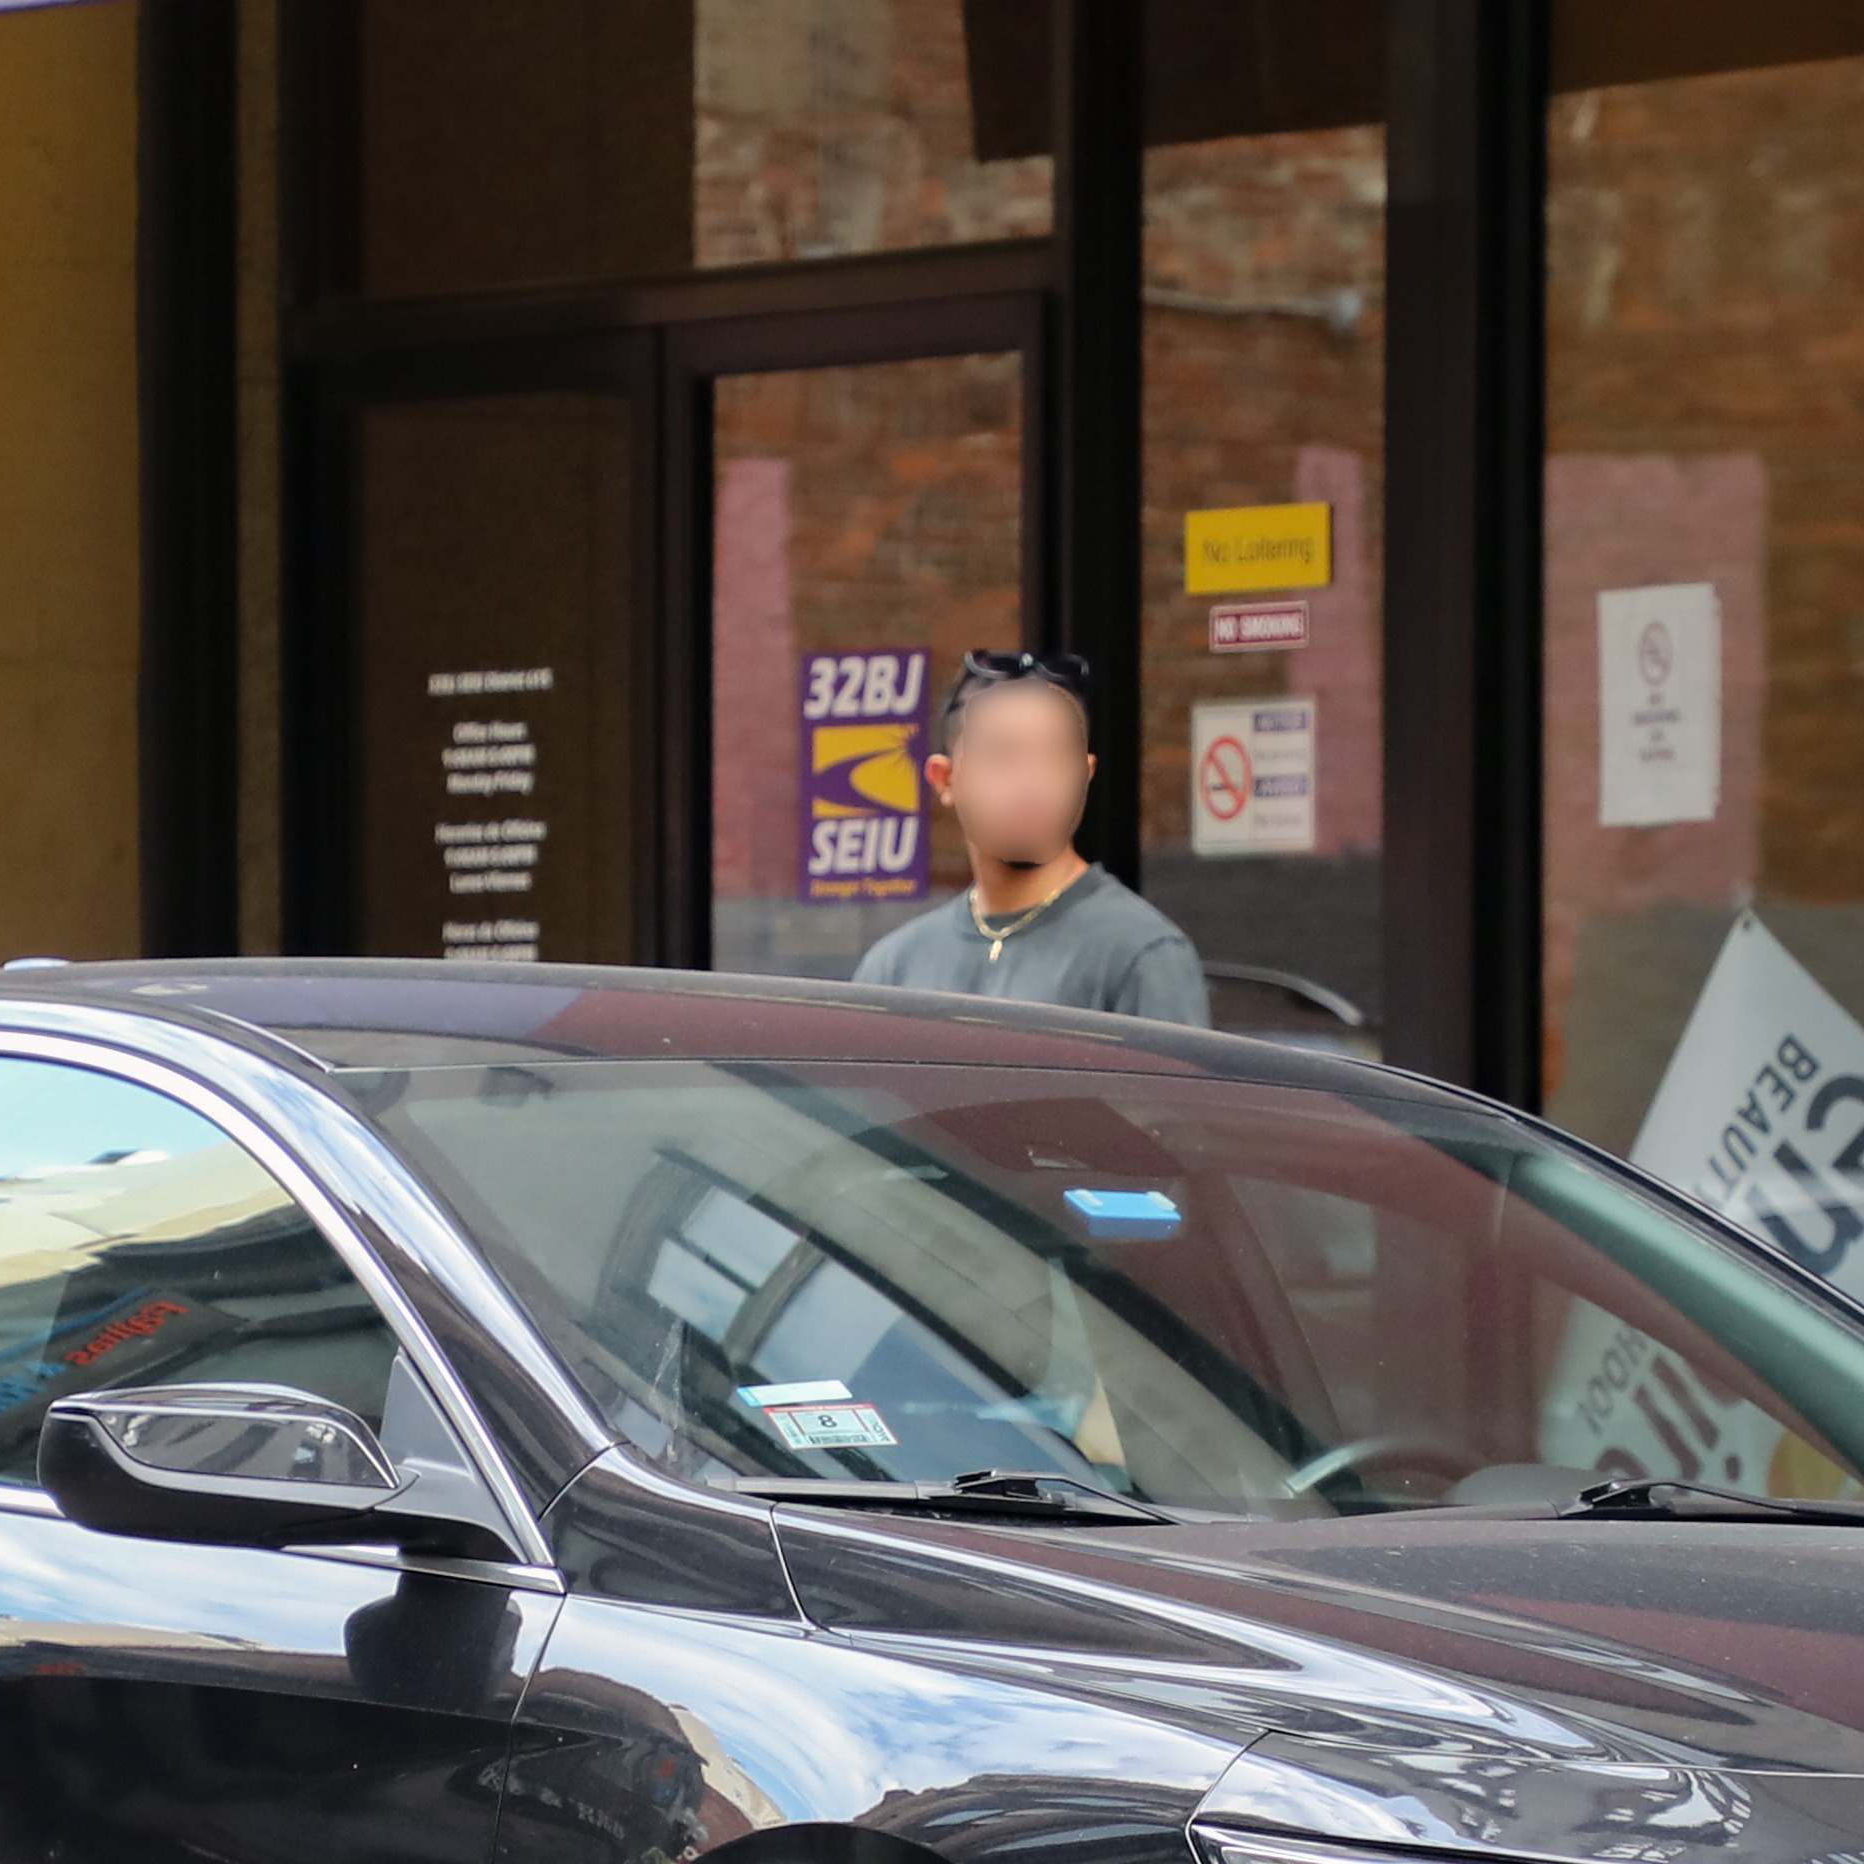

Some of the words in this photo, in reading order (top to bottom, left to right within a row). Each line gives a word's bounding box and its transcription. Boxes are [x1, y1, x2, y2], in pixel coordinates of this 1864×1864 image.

[803, 653, 925, 719] 32BJ
[808, 816, 920, 877] SEIU
[817, 1414, 838, 1429] 8
